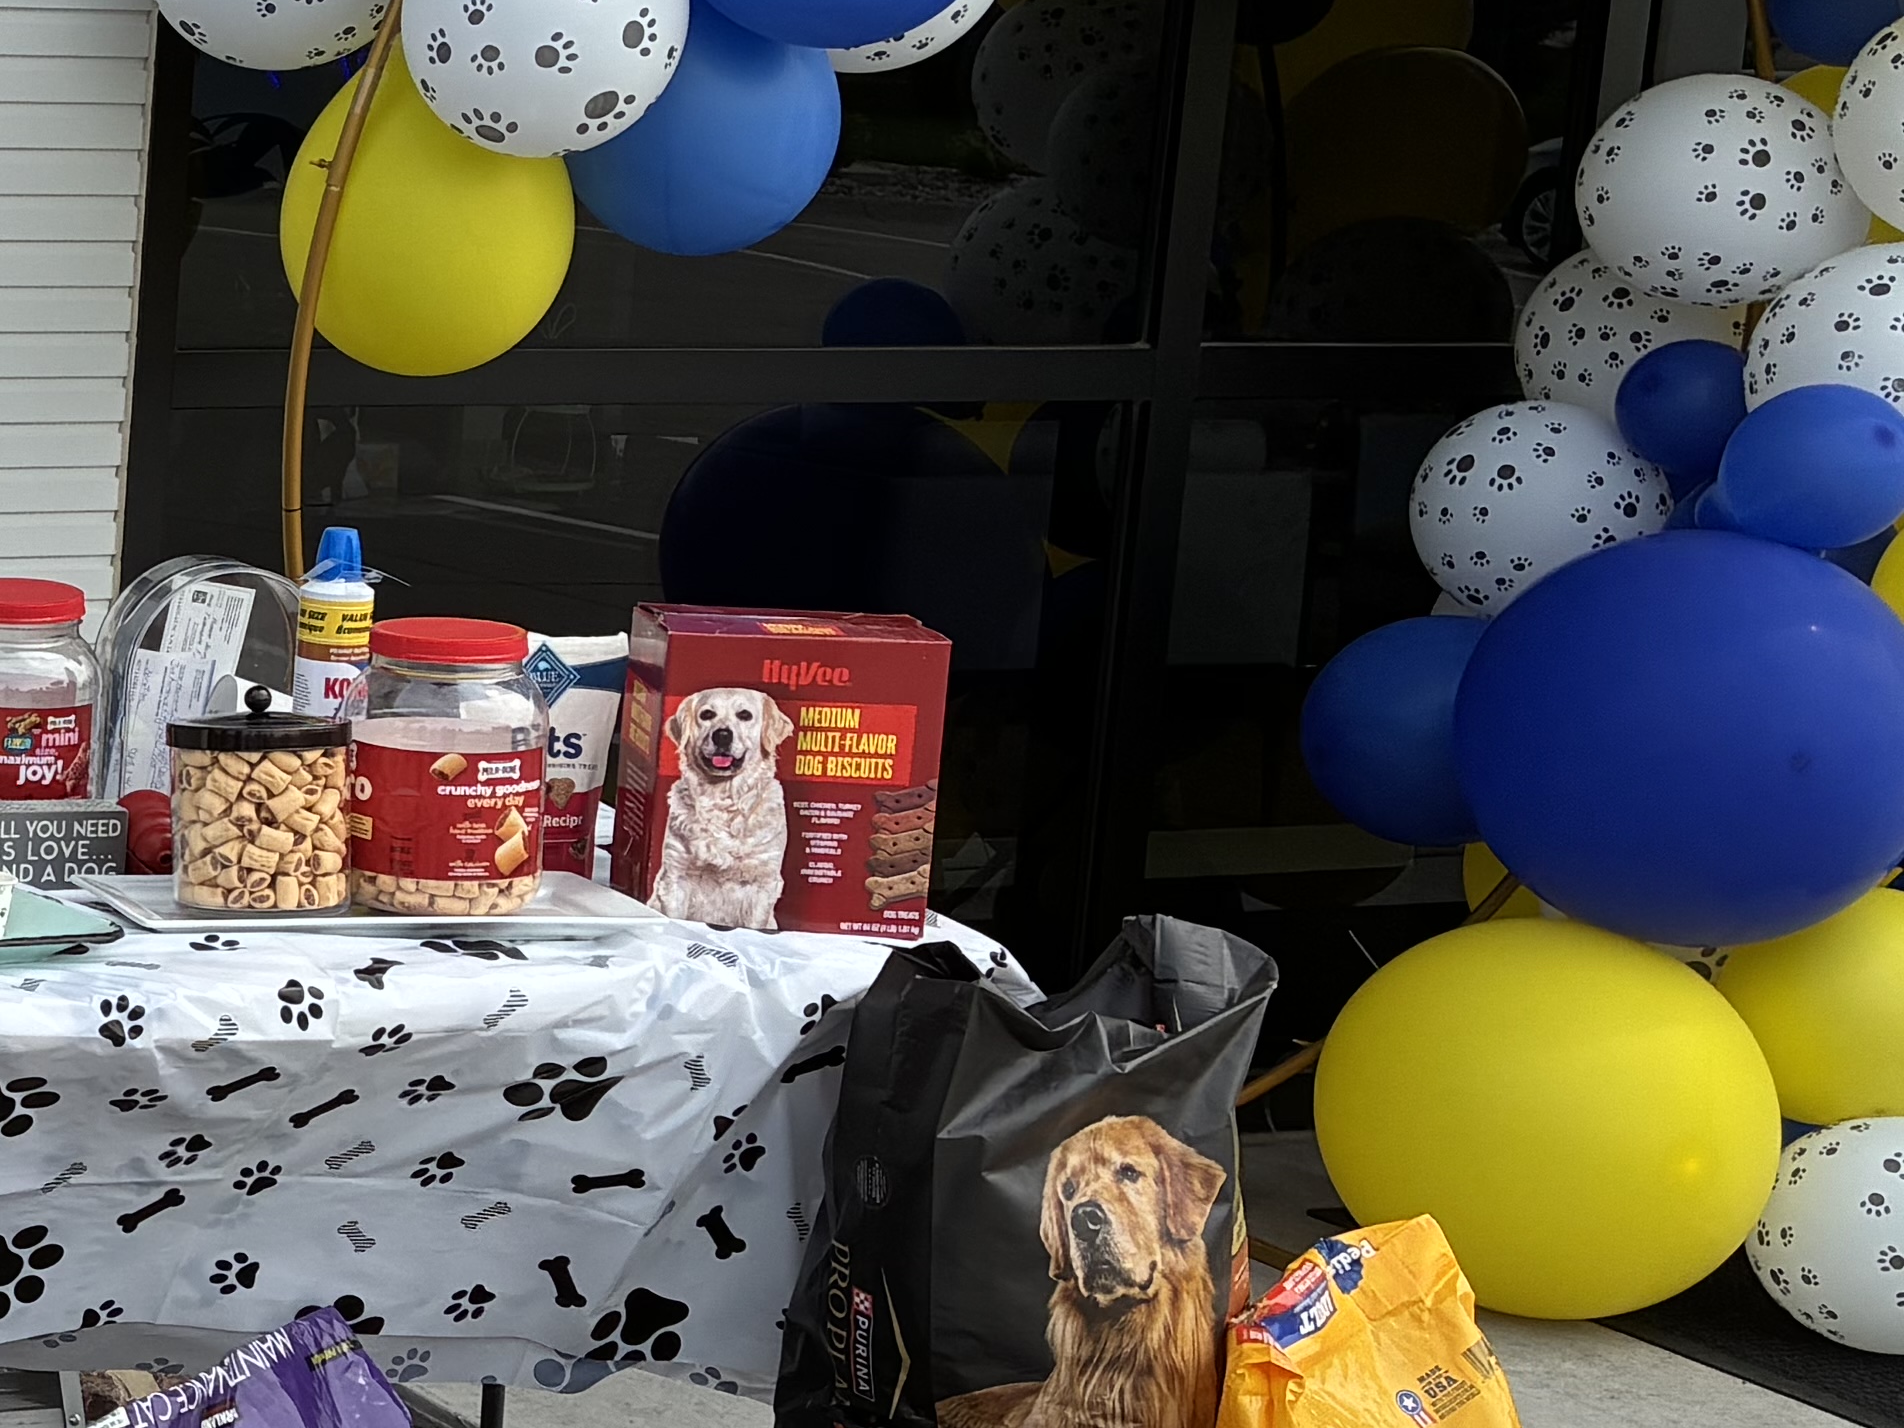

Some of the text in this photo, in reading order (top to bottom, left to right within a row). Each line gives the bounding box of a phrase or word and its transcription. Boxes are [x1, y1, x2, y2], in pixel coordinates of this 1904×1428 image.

[800, 707, 860, 728] MEDIUM
[42, 728, 78, 745] mini
[797, 732, 896, 754] MULTI-FLAVOR
[16, 760, 64, 785] joy!
[795, 757, 893, 779] DOG BISCUITS
[437, 784, 492, 797] crunchy
[467, 795, 524, 808] every day
[26, 821, 65, 838] YOU
[73, 820, 121, 837] NEED
[27, 840, 112, 860] LOVE...
[854, 1314, 874, 1393] PURINA
[1427, 1375, 1458, 1398] USA
